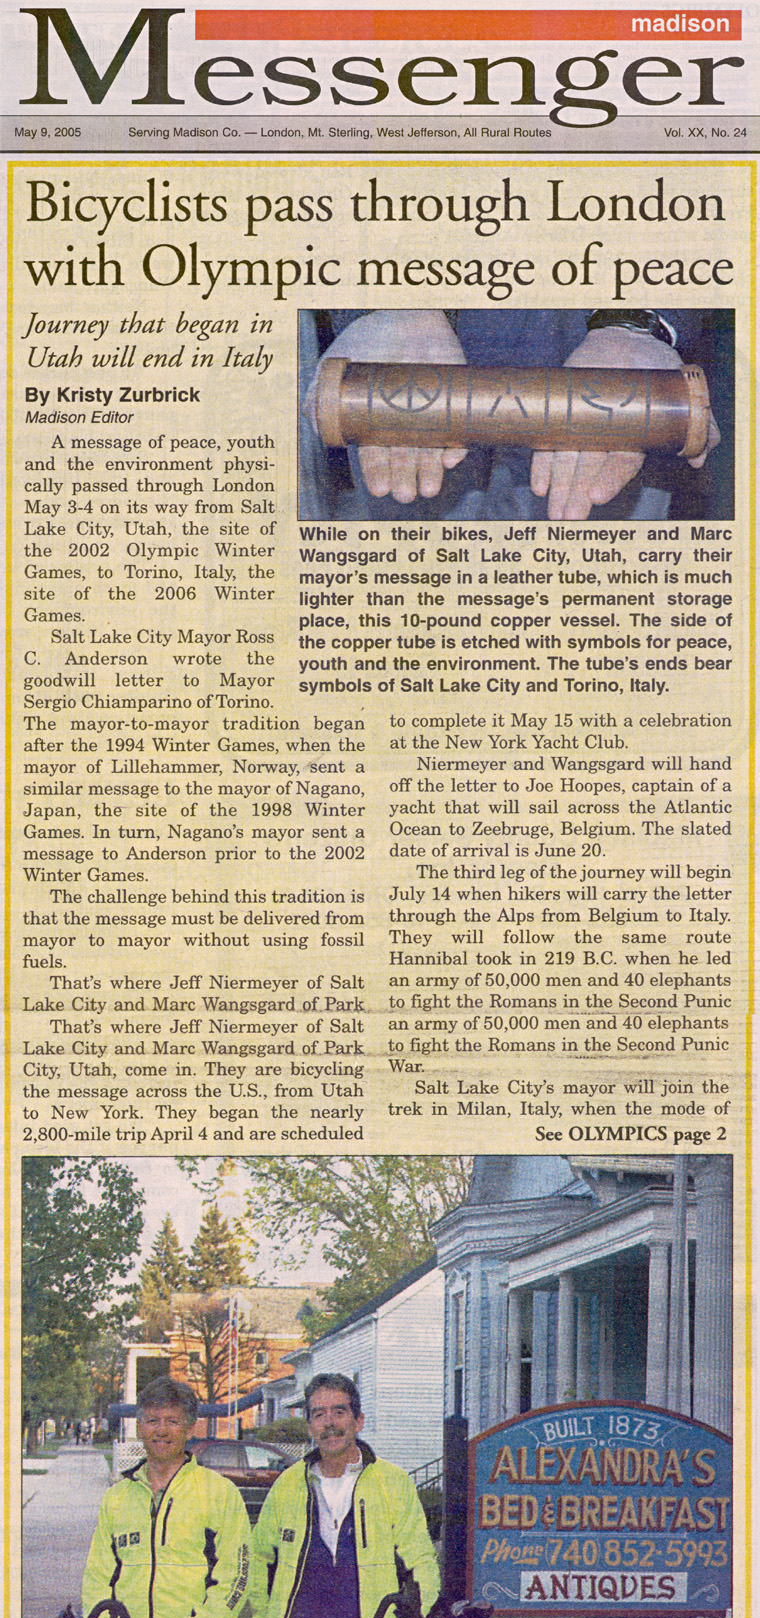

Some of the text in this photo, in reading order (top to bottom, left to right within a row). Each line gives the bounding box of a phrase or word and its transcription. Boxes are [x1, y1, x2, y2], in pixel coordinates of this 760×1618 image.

[630, 14, 730, 33] madison
[19, 8, 745, 128] Messenger
[14, 127, 82, 140] May 9, 2005
[128, 127, 170, 140] Serving
[173, 127, 219, 137] Madison
[222, 127, 241, 137] Co.
[261, 127, 304, 139] London,
[308, 127, 324, 137] Mt.
[328, 127, 373, 140] Sterling,
[376, 127, 404, 138] West
[407, 127, 460, 138] Jefferson,
[463, 127, 477, 137] All
[481, 127, 510, 137] Rural
[514, 127, 552, 138] Routes
[664, 127, 747, 139] Vol. XX, No. 24
[26, 177, 726, 237] Bicyclists pass through London
[23, 240, 734, 301] with Olympic message of peace
[21, 311, 273, 341] Journey that began in
[28, 345, 273, 375] Utah will end in Italy
[25, 387, 200, 407] By Kristy Zurbrick
[25, 411, 134, 424] Madison Editor
[51, 434, 275, 452] A message of peace, youth
[299, 526, 732, 544] While on their bikes, Jeff Niermeyer and Marc
[23, 867, 148, 882] Winter Games.
[50, 889, 364, 907] The challenge behind this tradition is
[389, 886, 732, 904] July 14 when hikers will carry the letter
[535, 1126, 726, 1146] See OLYMPICS page 2
[543, 1415, 661, 1442] BUILT 1873
[489, 1445, 716, 1487] ALEXANDRA'S
[478, 1494, 538, 1530] BED
[556, 1495, 730, 1532] BREAKFAST
[480, 1538, 544, 1565] Phone
[545, 1537, 599, 1566] (740)
[524, 1573, 676, 1601] ANTIQUES
